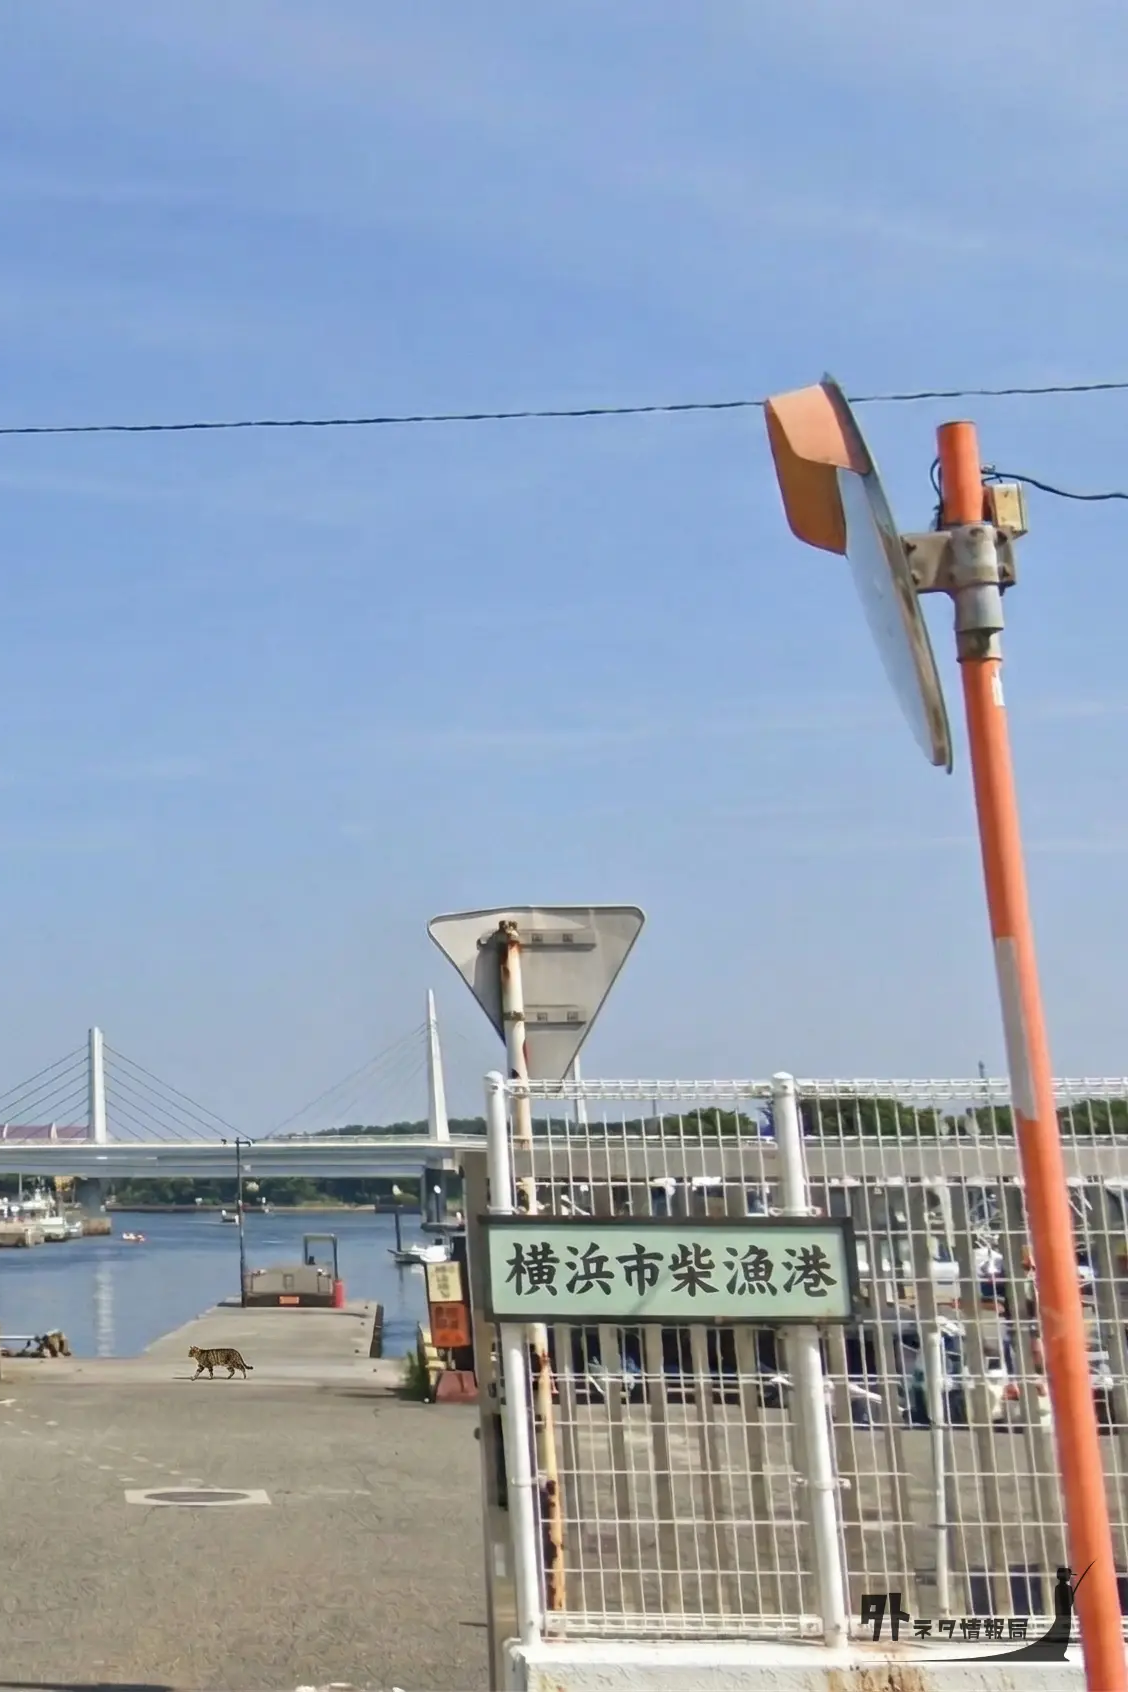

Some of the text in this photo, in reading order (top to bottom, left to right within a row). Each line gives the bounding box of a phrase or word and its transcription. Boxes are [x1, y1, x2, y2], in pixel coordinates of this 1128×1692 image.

[505, 1241, 838, 1298] 横浜市柴漁港
